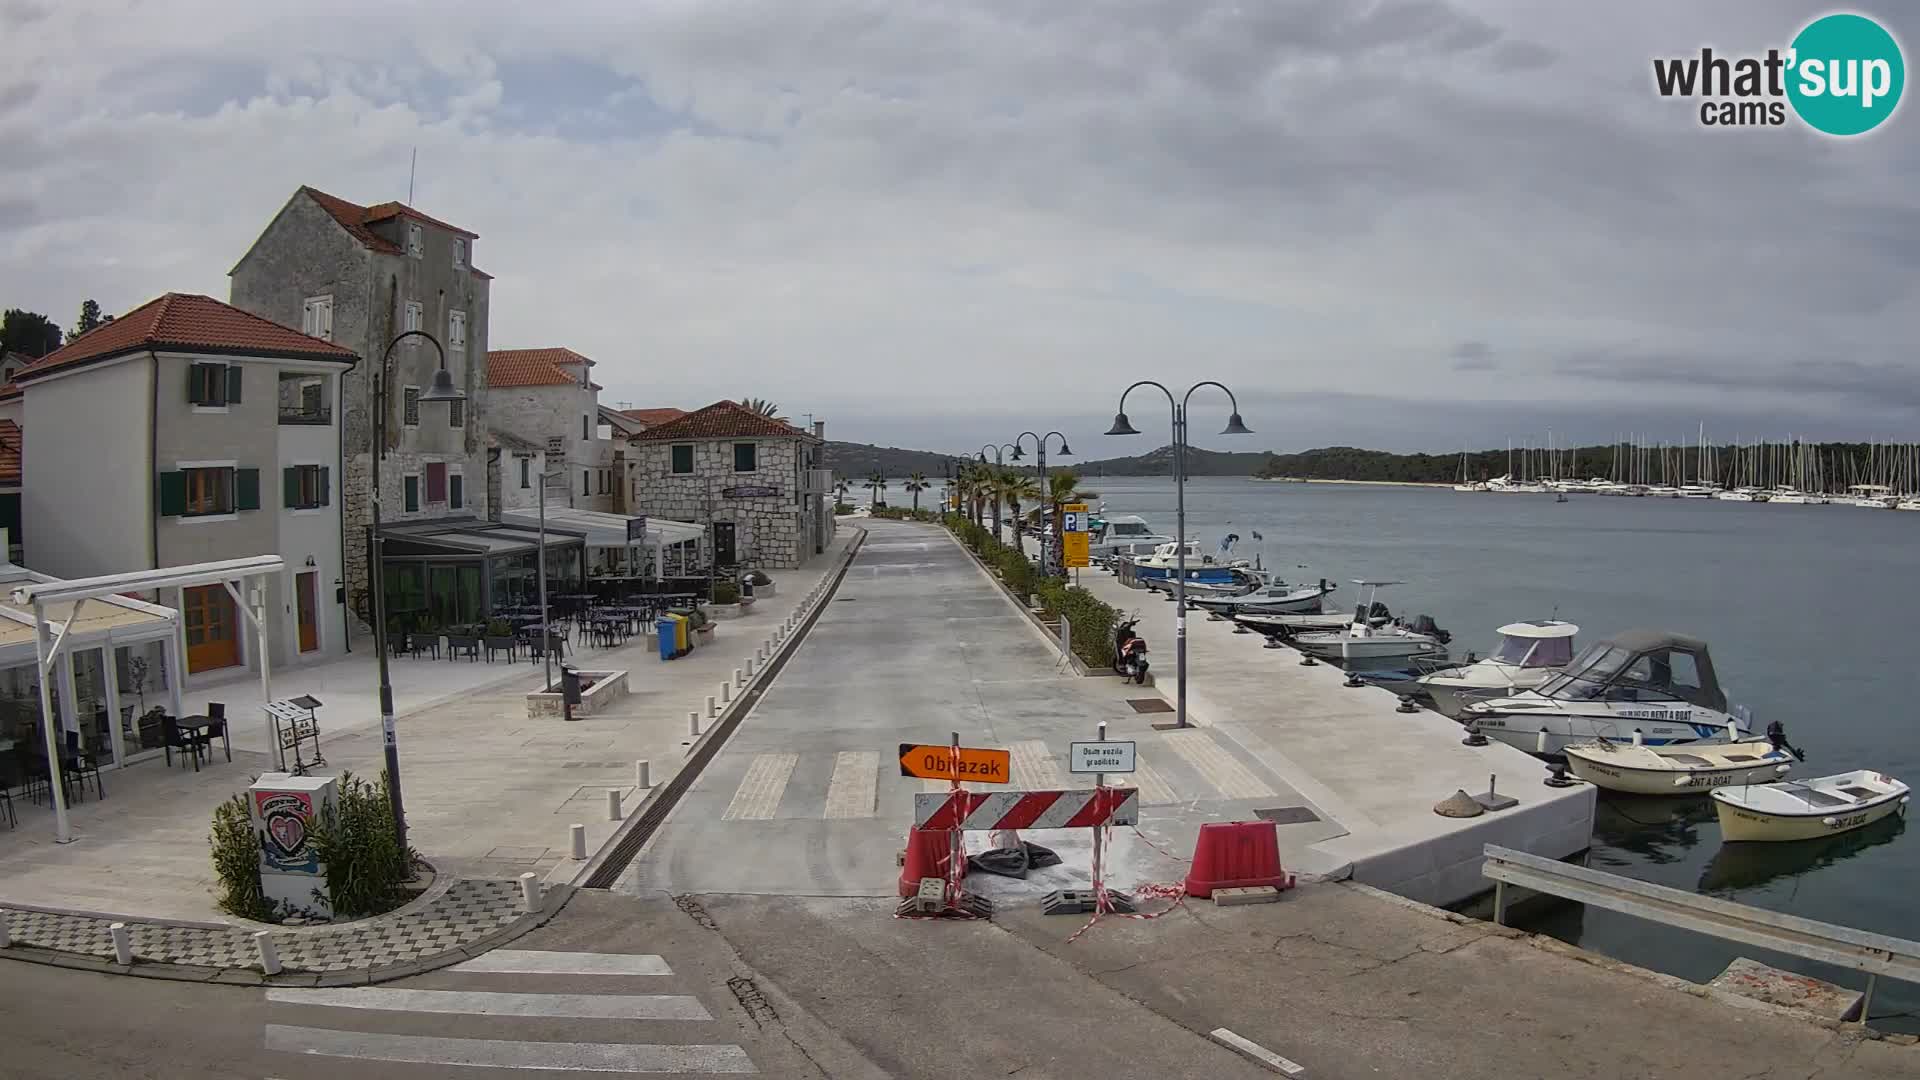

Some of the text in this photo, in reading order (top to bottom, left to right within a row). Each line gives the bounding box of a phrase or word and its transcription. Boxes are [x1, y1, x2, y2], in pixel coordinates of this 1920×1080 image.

[1065, 514, 1076, 530] P
[1650, 710, 1668, 719] RENT
[1669, 710, 1674, 720] A
[1675, 710, 1692, 721] BOAT
[1712, 775, 1732, 786] BOAT
